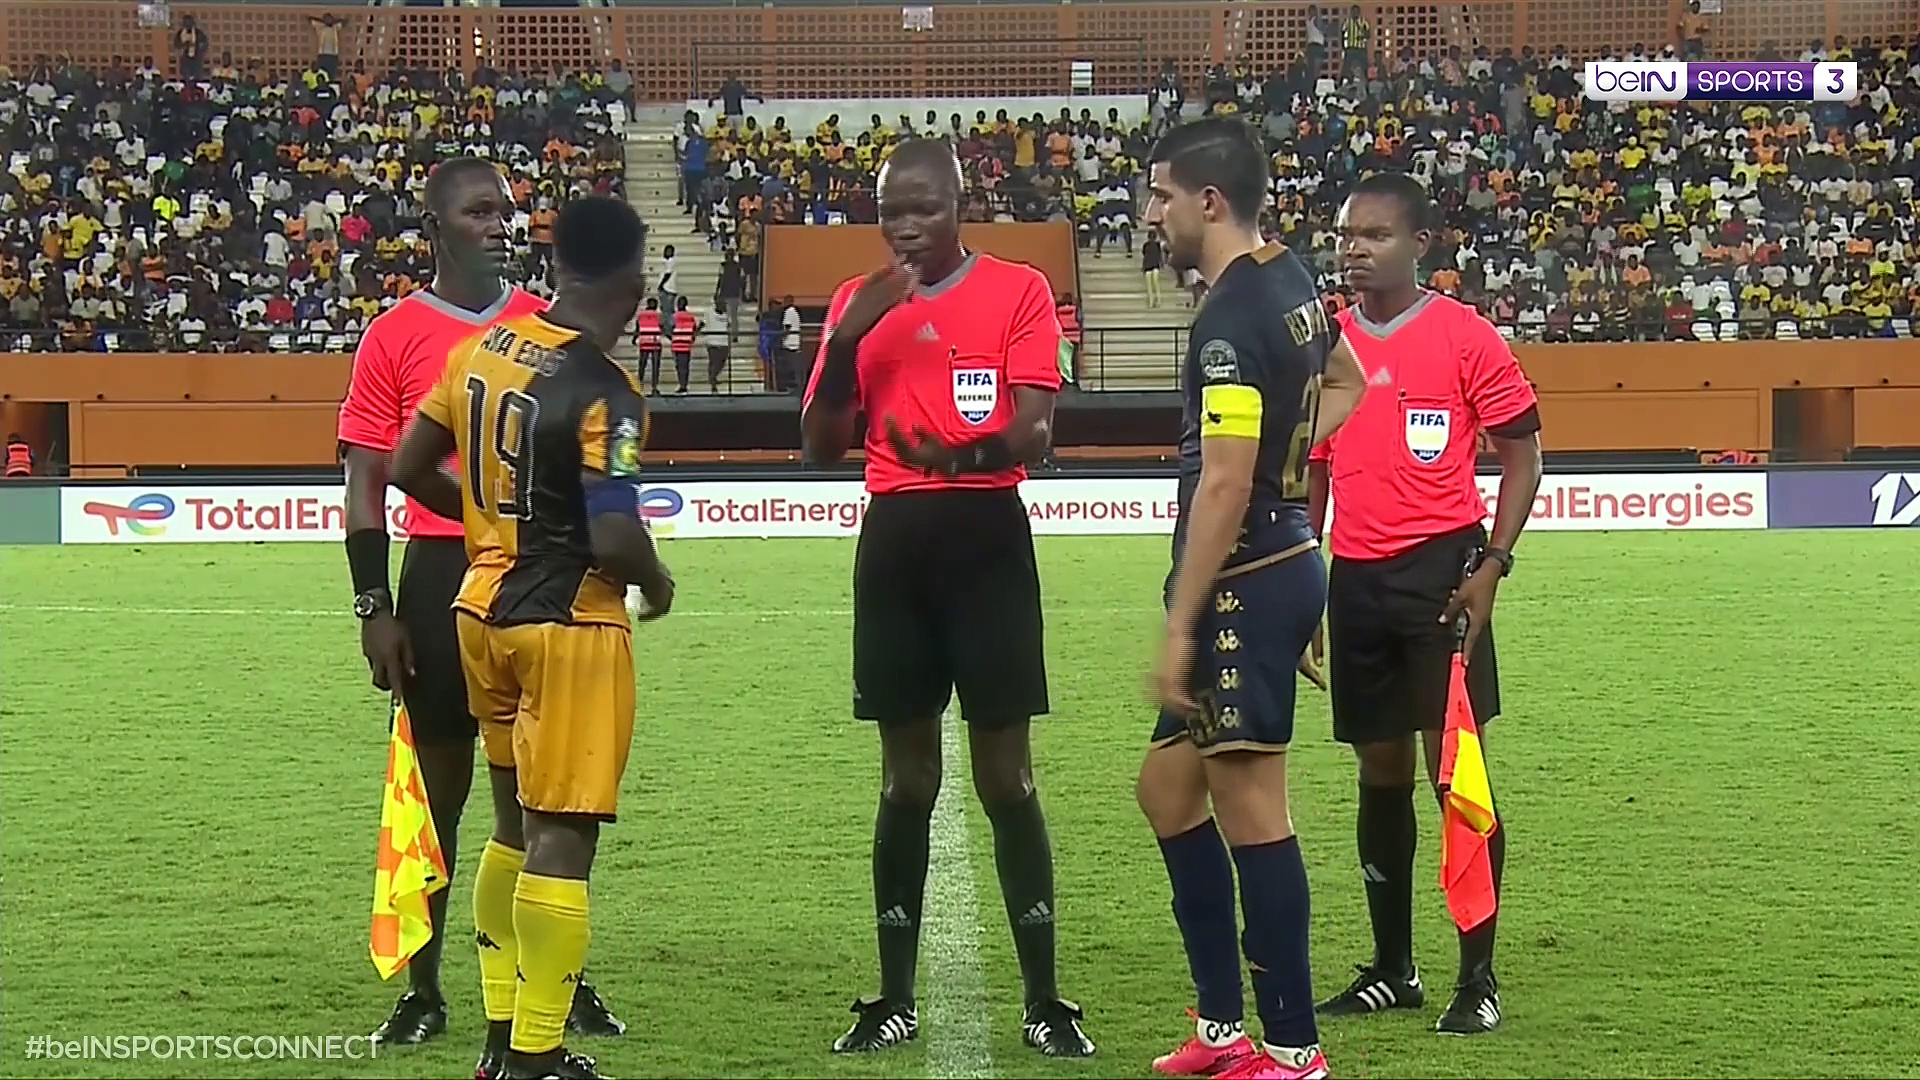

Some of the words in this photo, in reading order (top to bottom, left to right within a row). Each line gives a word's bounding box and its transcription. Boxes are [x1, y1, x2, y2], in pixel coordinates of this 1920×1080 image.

[957, 372, 993, 386] FIFA
[957, 394, 993, 402] REFEREE
[1410, 413, 1446, 426] FIFA
[464, 374, 540, 521] 19
[185, 497, 411, 538] TotalEng
[690, 496, 867, 528] TotalEnergi
[1028, 501, 1143, 520] AMPIONS
